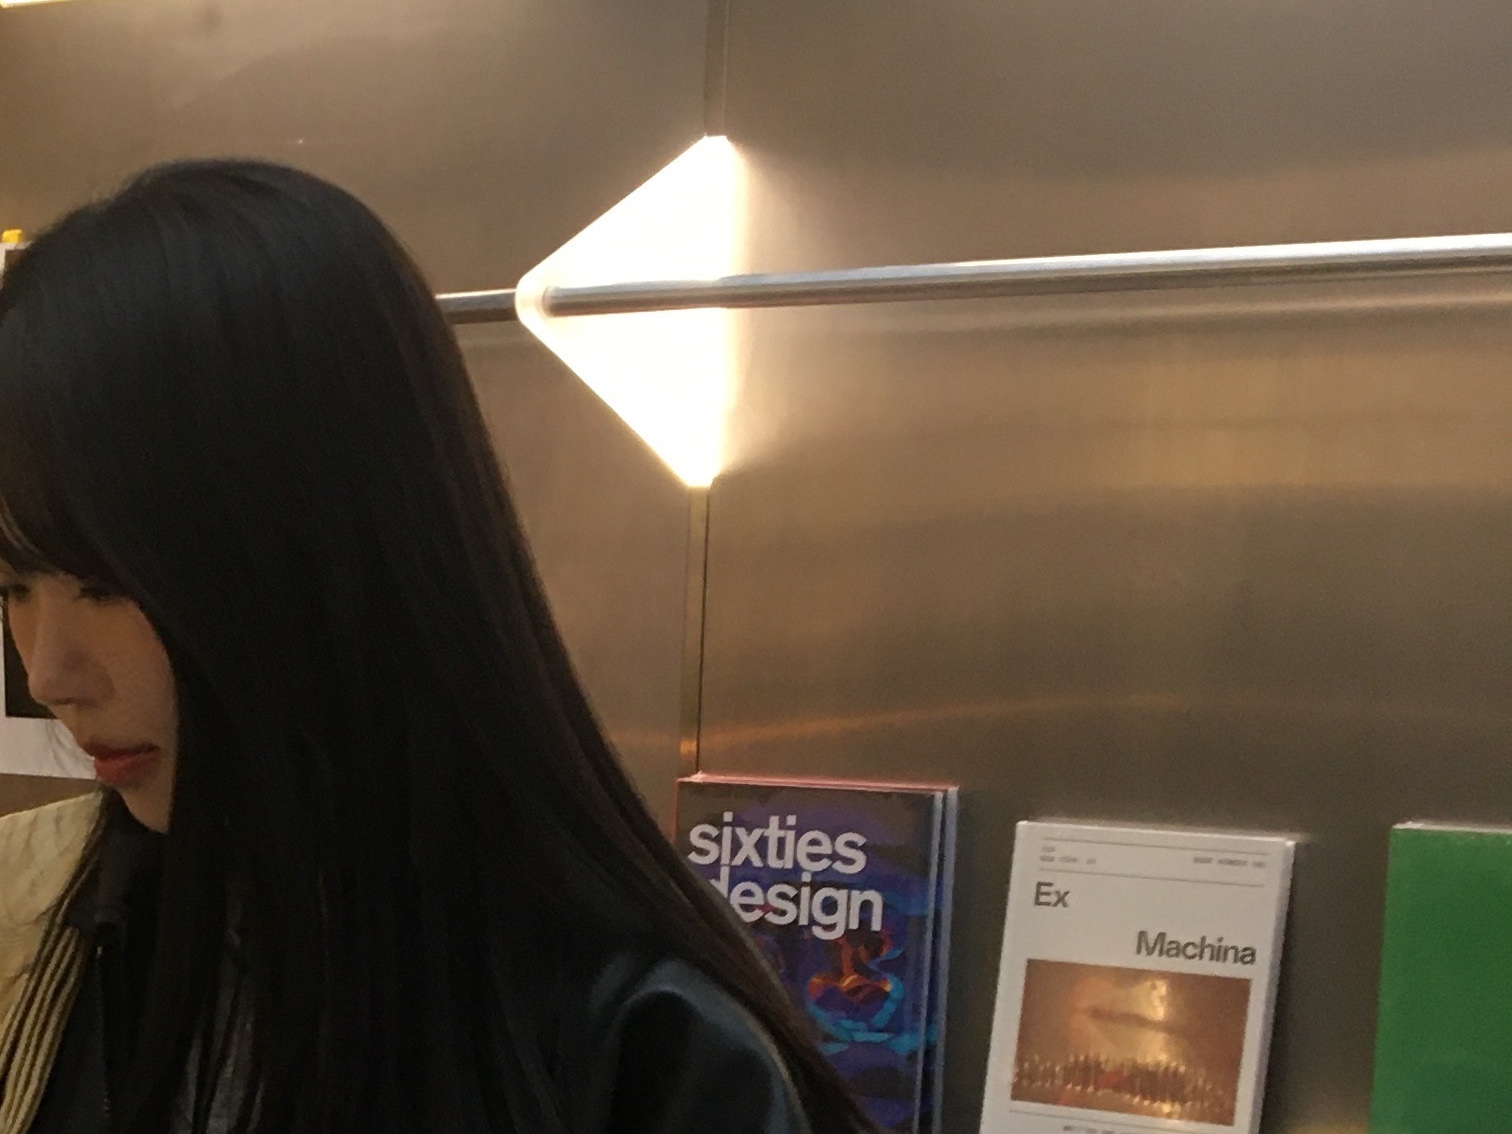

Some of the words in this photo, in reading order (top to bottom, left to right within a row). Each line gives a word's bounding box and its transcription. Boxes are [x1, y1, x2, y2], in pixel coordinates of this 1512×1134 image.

[688, 811, 867, 874] sixties
[1034, 881, 1070, 908] Ex
[1136, 930, 1256, 965] Machina
